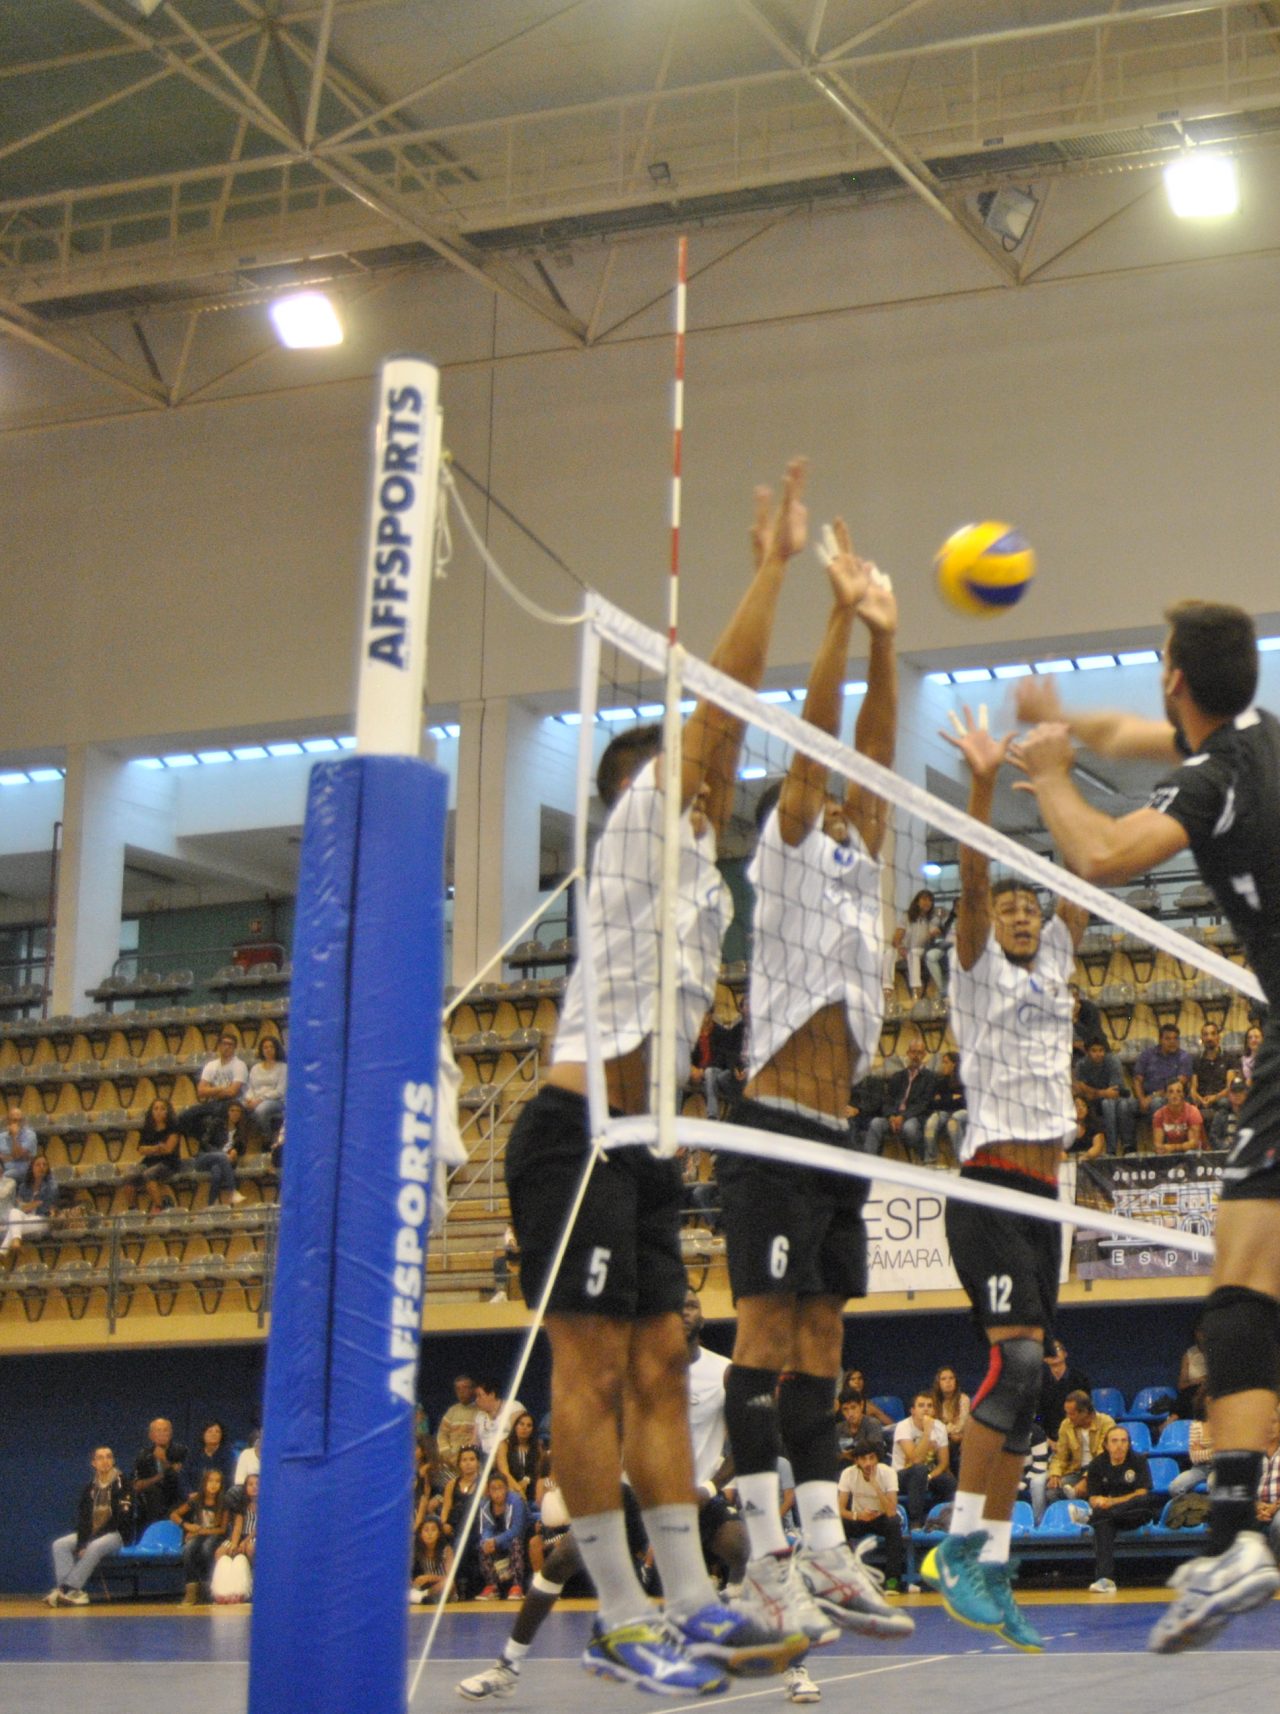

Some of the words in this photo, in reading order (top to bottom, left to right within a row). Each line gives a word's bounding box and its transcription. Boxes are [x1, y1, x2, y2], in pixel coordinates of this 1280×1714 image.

[367, 385, 423, 671] AFFSPORTS
[388, 1080, 433, 1406] AFFSPORTS
[770, 1235, 790, 1278] 6
[586, 1246, 611, 1296] 5
[987, 1274, 1014, 1313] 12
